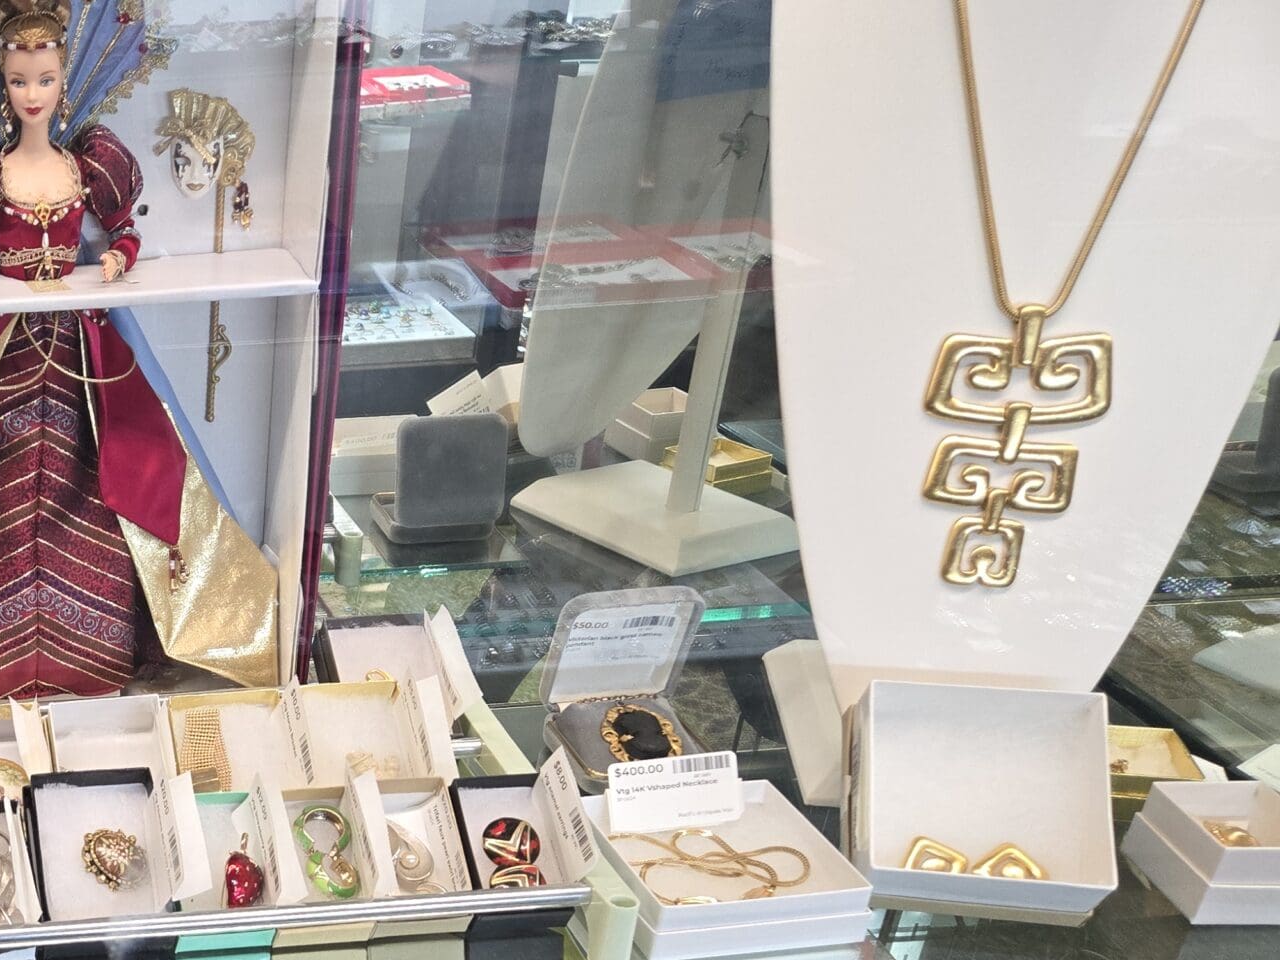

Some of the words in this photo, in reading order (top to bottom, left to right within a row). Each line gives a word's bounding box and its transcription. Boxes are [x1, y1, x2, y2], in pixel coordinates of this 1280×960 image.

[573, 621, 609, 630] $50.00
[553, 760, 569, 791] $8.00
[614, 763, 664, 778] $400.00
[631, 786, 646, 794] 14K
[647, 783, 681, 791] Vshaped
[682, 778, 718, 787] Necklace
